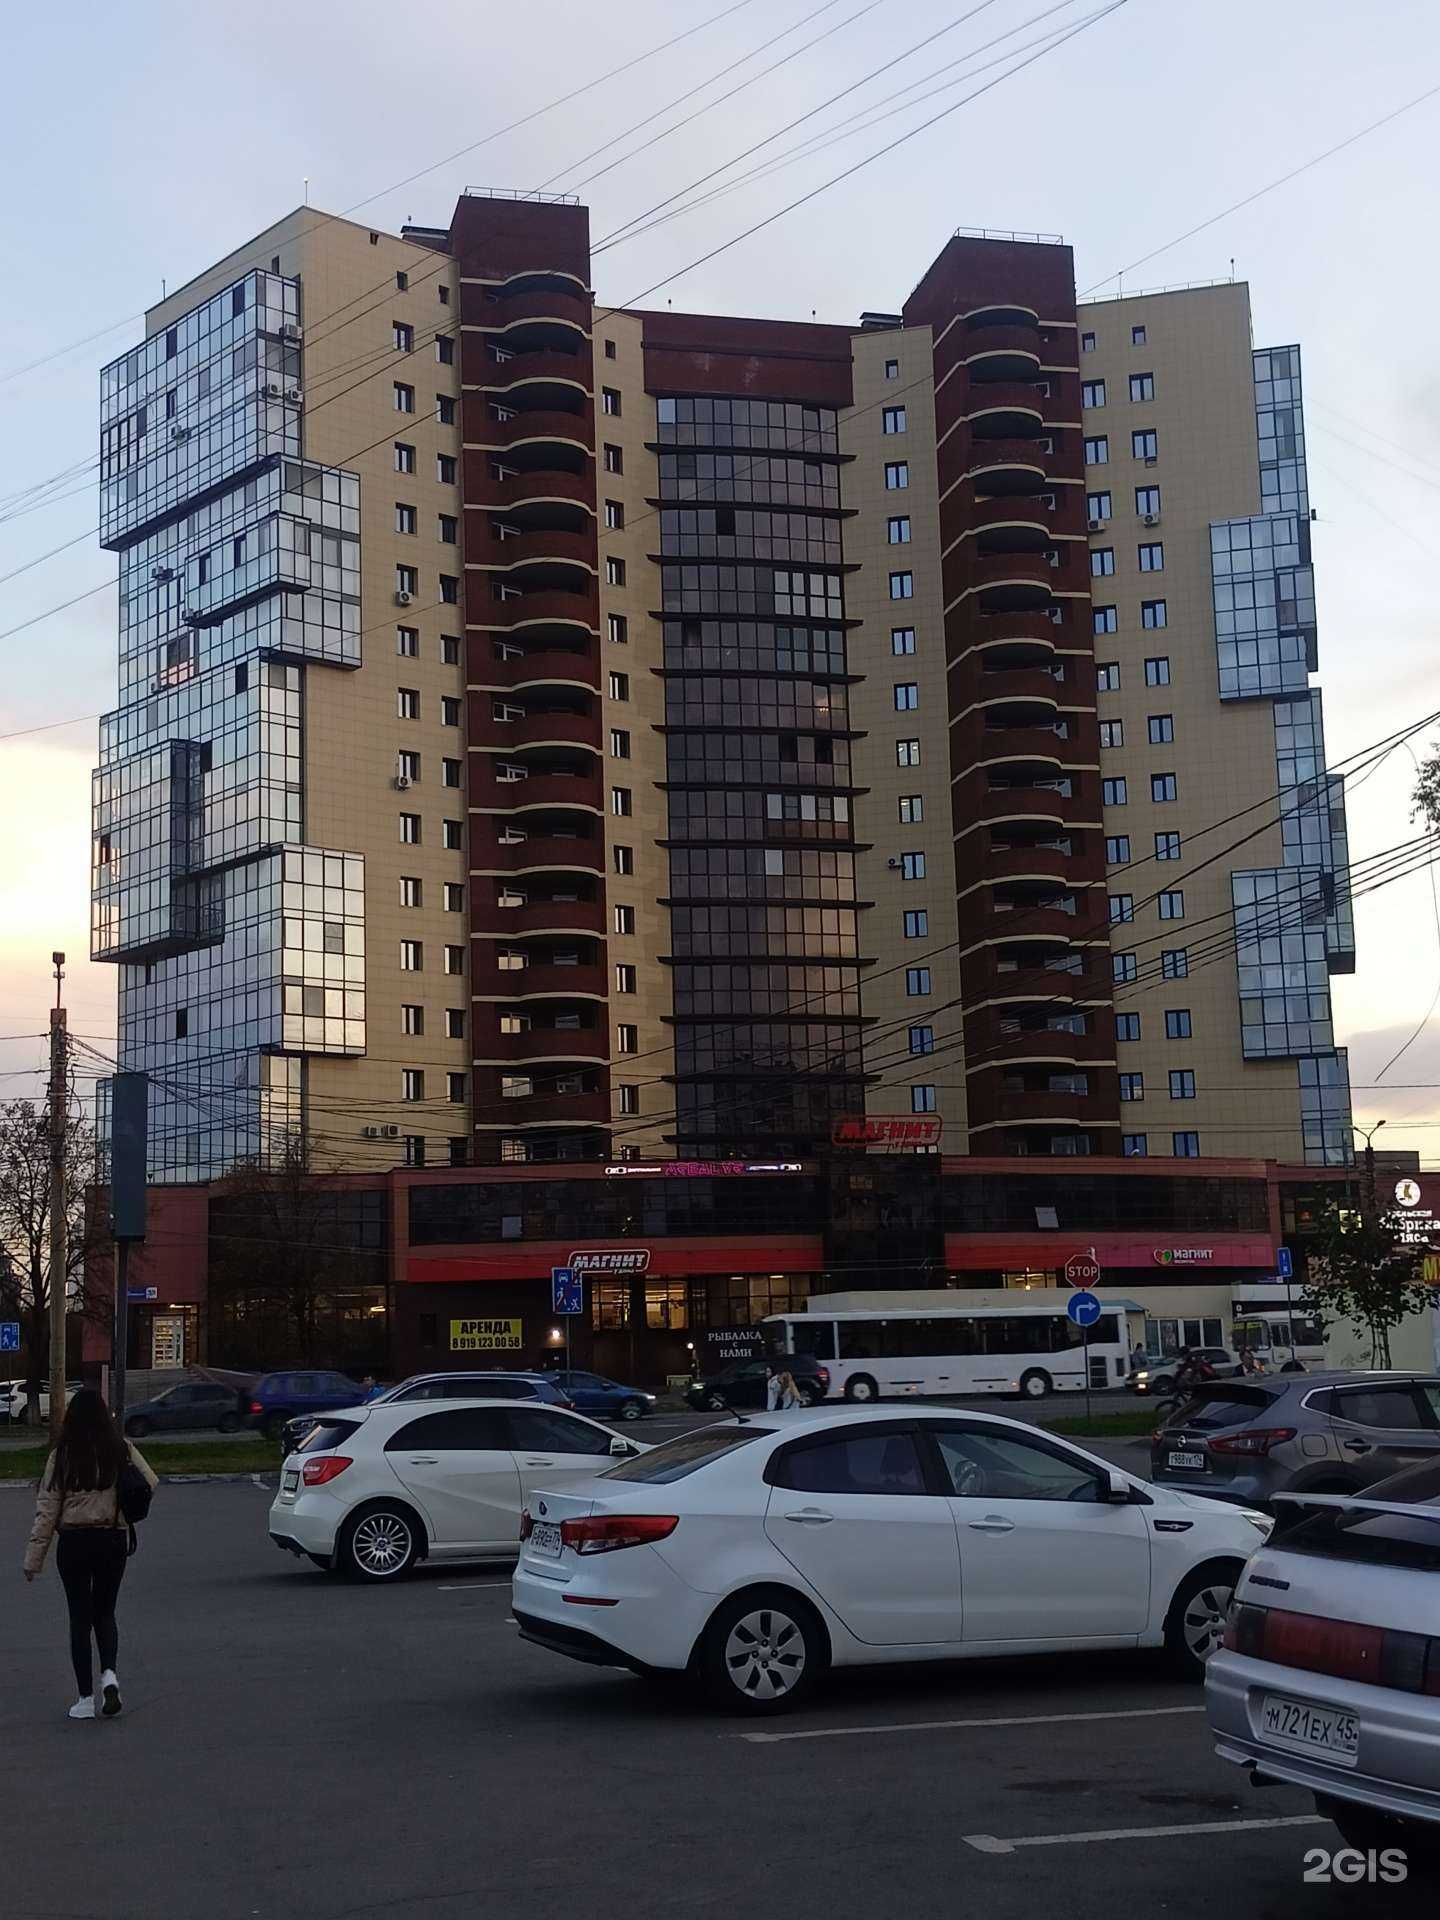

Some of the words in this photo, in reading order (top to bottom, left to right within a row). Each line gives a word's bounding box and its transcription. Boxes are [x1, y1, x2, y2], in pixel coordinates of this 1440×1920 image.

[574, 1255, 645, 1268] МАГНИТ
[1068, 1266, 1098, 1277] STOP
[461, 1321, 512, 1335] АРЕНДА
[452, 1338, 459, 1348] 8
[460, 1338, 476, 1348] 919
[479, 1337, 493, 1348] 123
[494, 1336, 507, 1347] 00
[708, 1331, 762, 1341] РЫБАЛКА
[720, 1348, 752, 1358] НАМИ
[1336, 1716, 1356, 1740] 45
